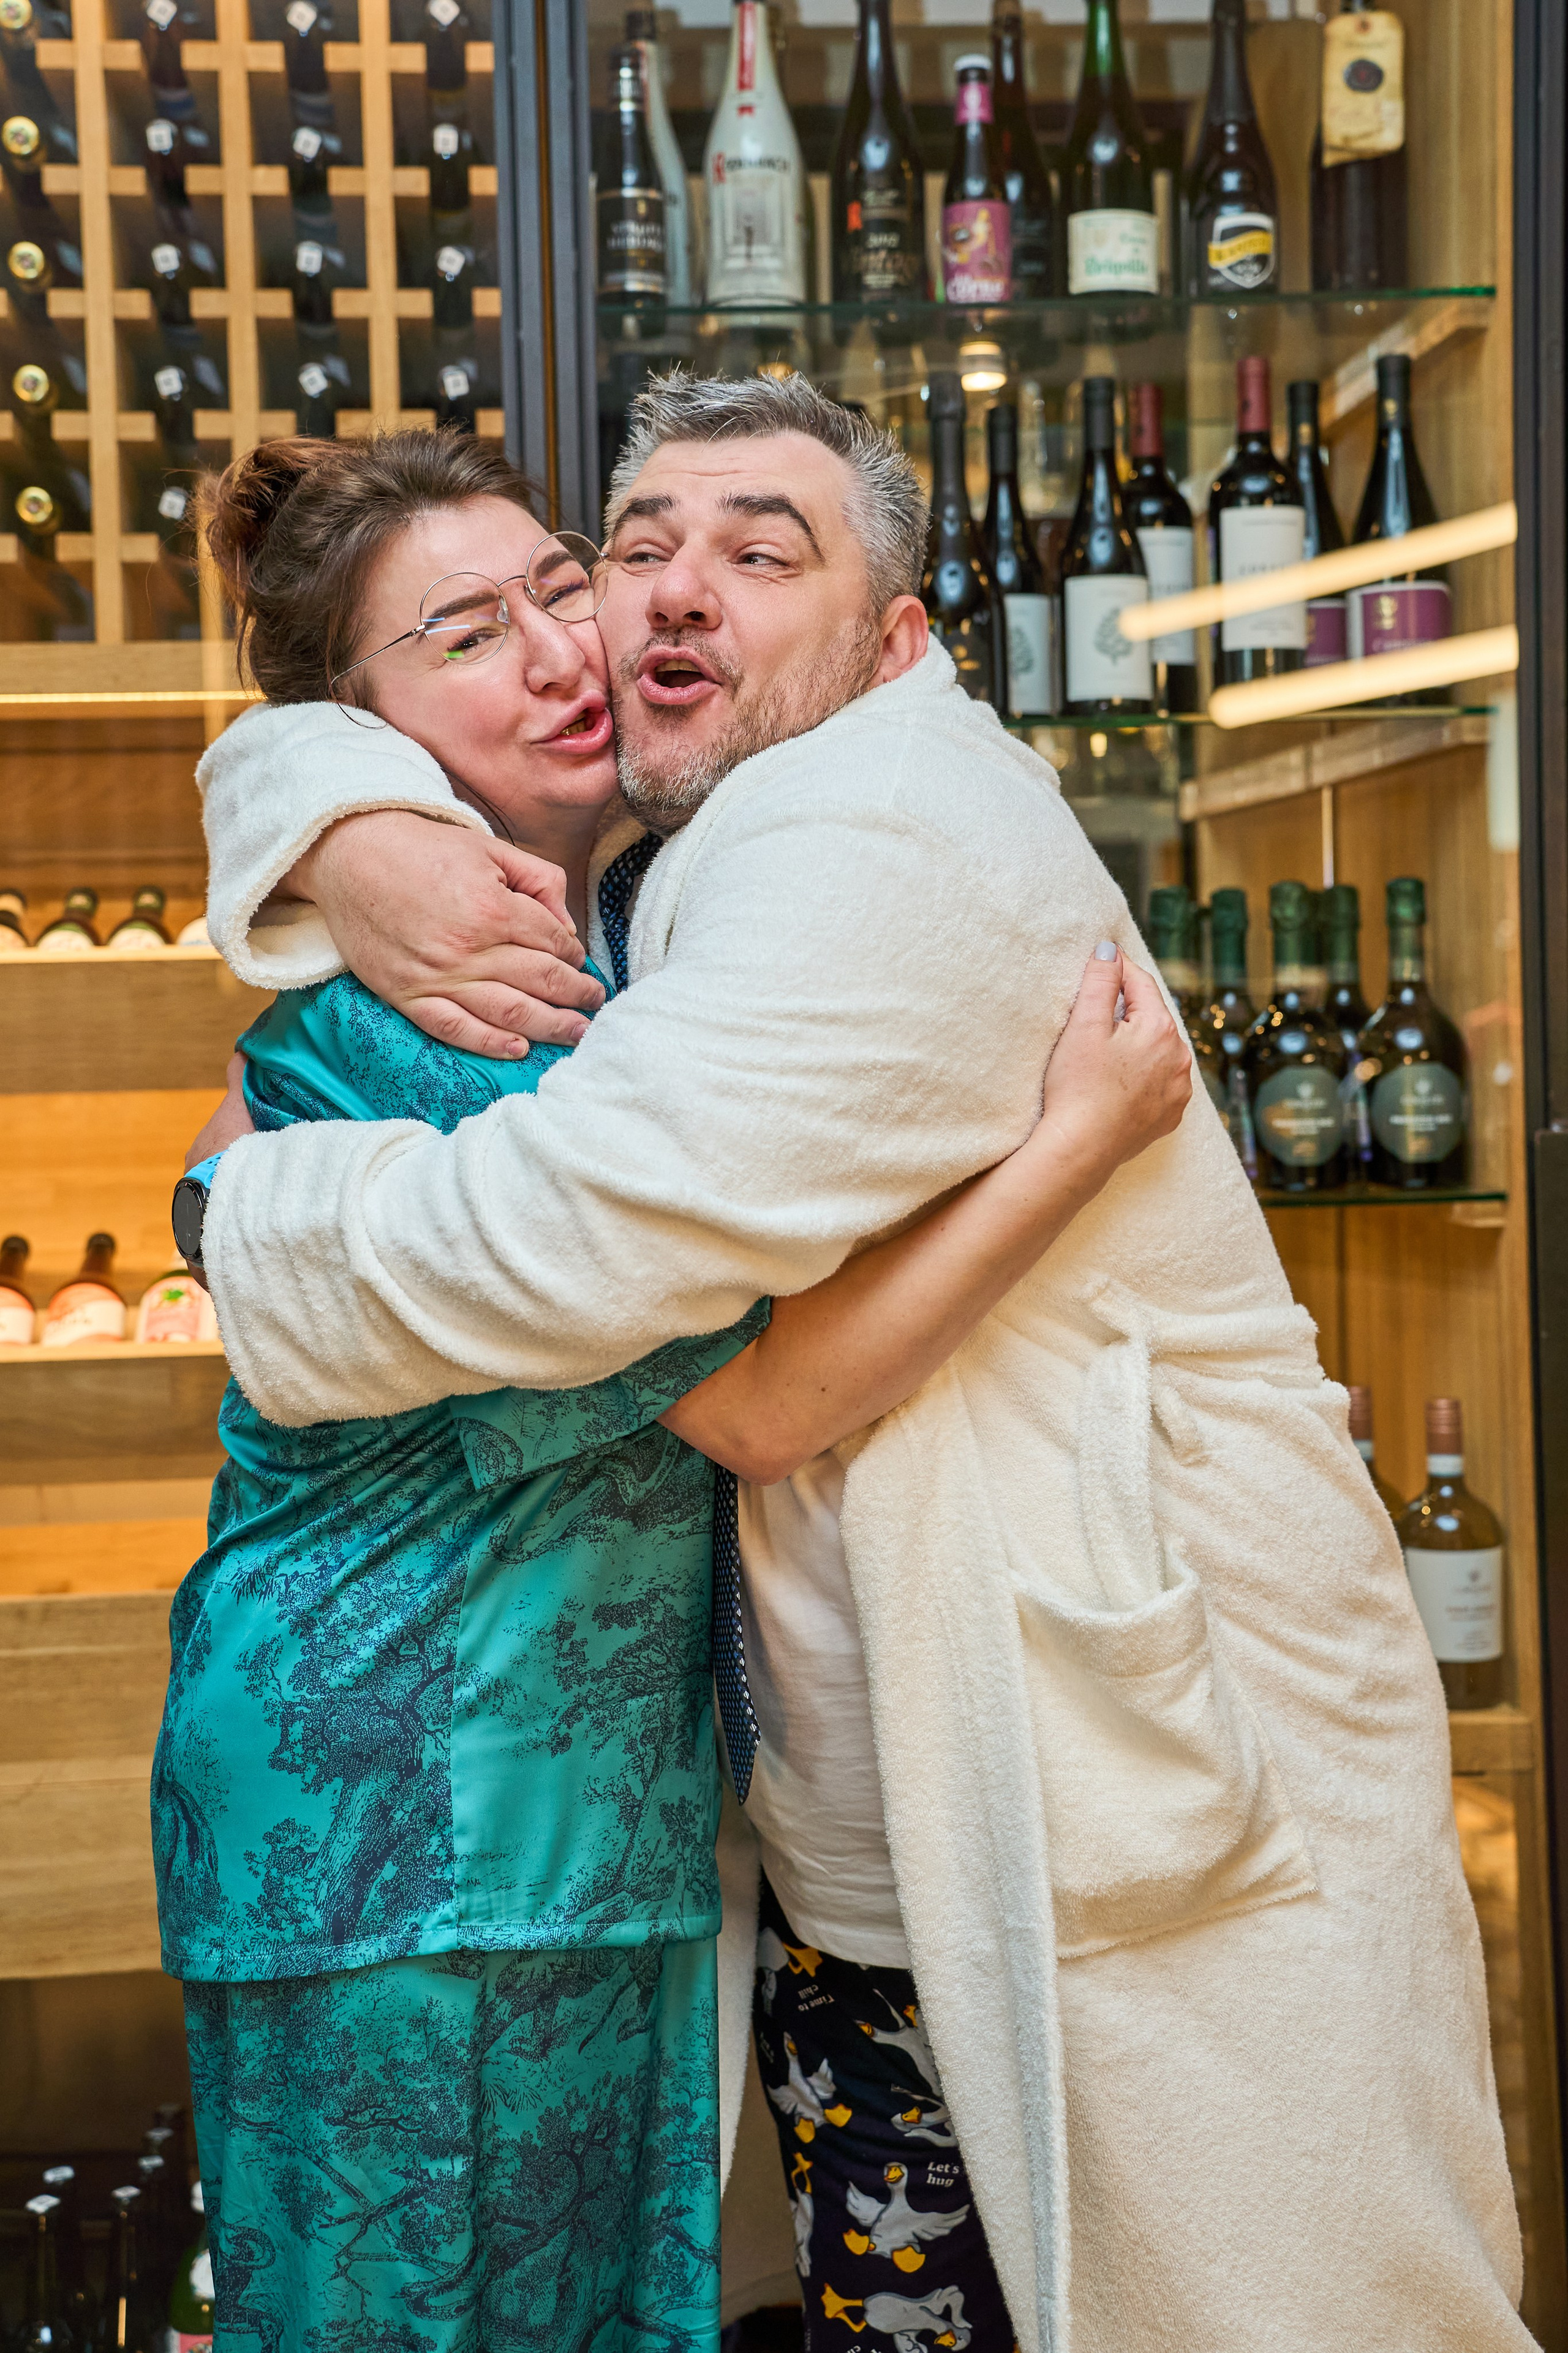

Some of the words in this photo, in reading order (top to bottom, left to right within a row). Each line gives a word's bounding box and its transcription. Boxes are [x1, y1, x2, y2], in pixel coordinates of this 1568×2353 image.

[798, 1985, 819, 1999] chill
[809, 1994, 834, 2007] Time
[927, 2161, 960, 2174] Let's
[927, 2173, 954, 2187] hug
